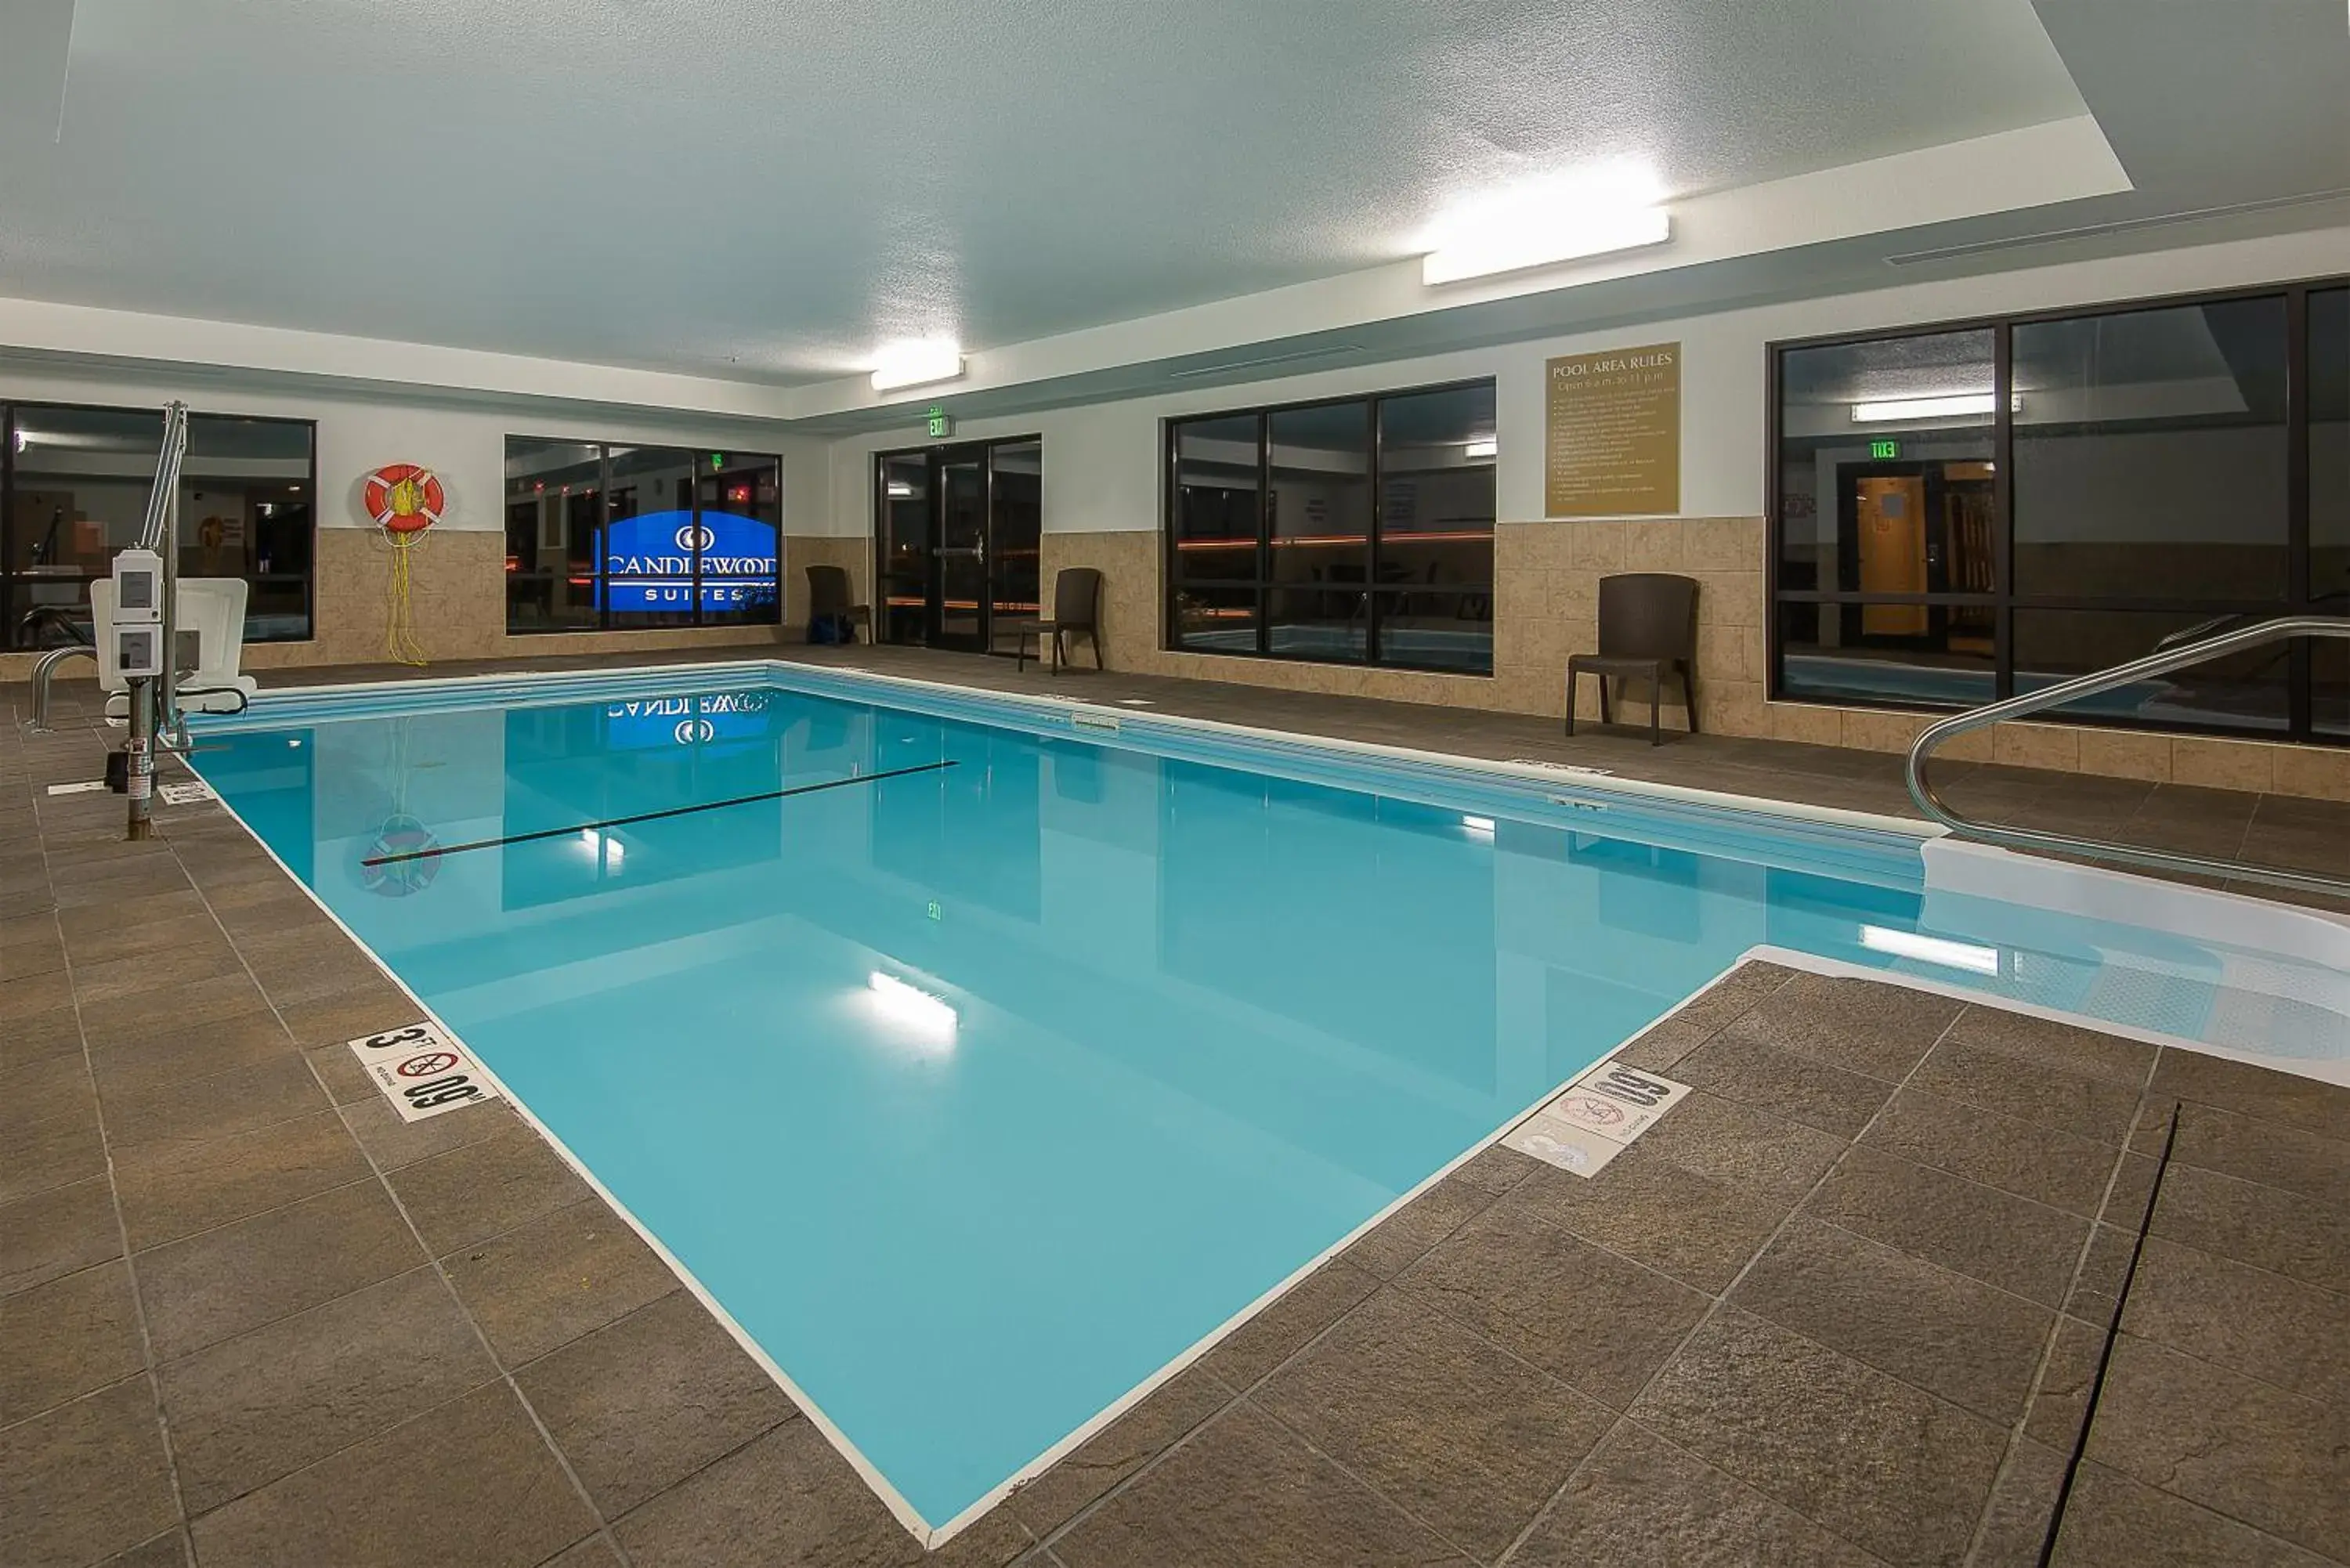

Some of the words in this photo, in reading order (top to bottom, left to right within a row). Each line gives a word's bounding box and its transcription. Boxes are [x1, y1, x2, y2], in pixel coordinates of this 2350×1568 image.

[1553, 363, 1588, 378] POOL
[1593, 359, 1626, 373] AREA
[1630, 352, 1673, 369] RULES
[366, 1028, 426, 1049] 3
[403, 1075, 479, 1109] 0.9
